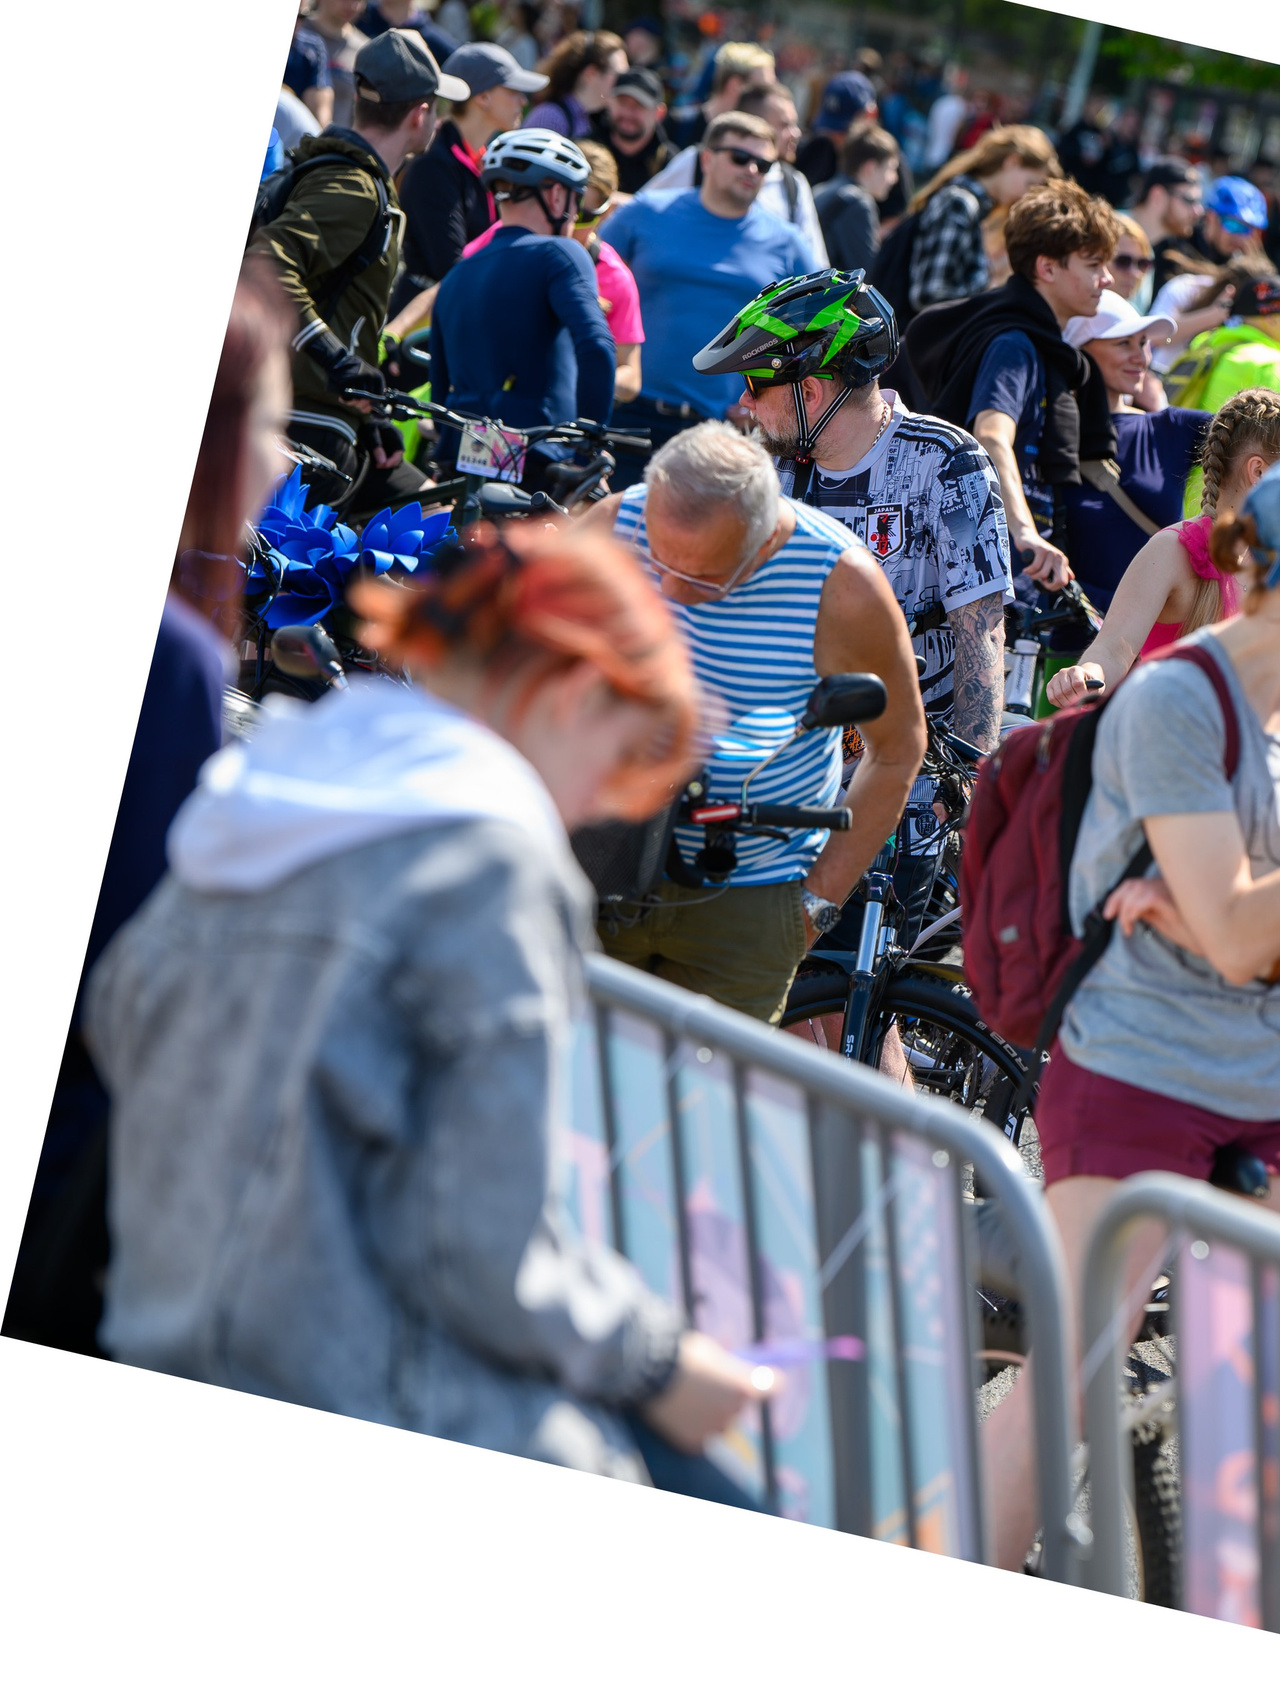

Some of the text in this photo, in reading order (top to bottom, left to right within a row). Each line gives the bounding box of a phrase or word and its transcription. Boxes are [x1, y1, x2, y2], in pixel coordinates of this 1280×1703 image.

[742, 337, 779, 361] ROCKBROS
[873, 506, 895, 515] JAPAN
[942, 503, 964, 515] TOKYO
[874, 540, 893, 551] JFA
